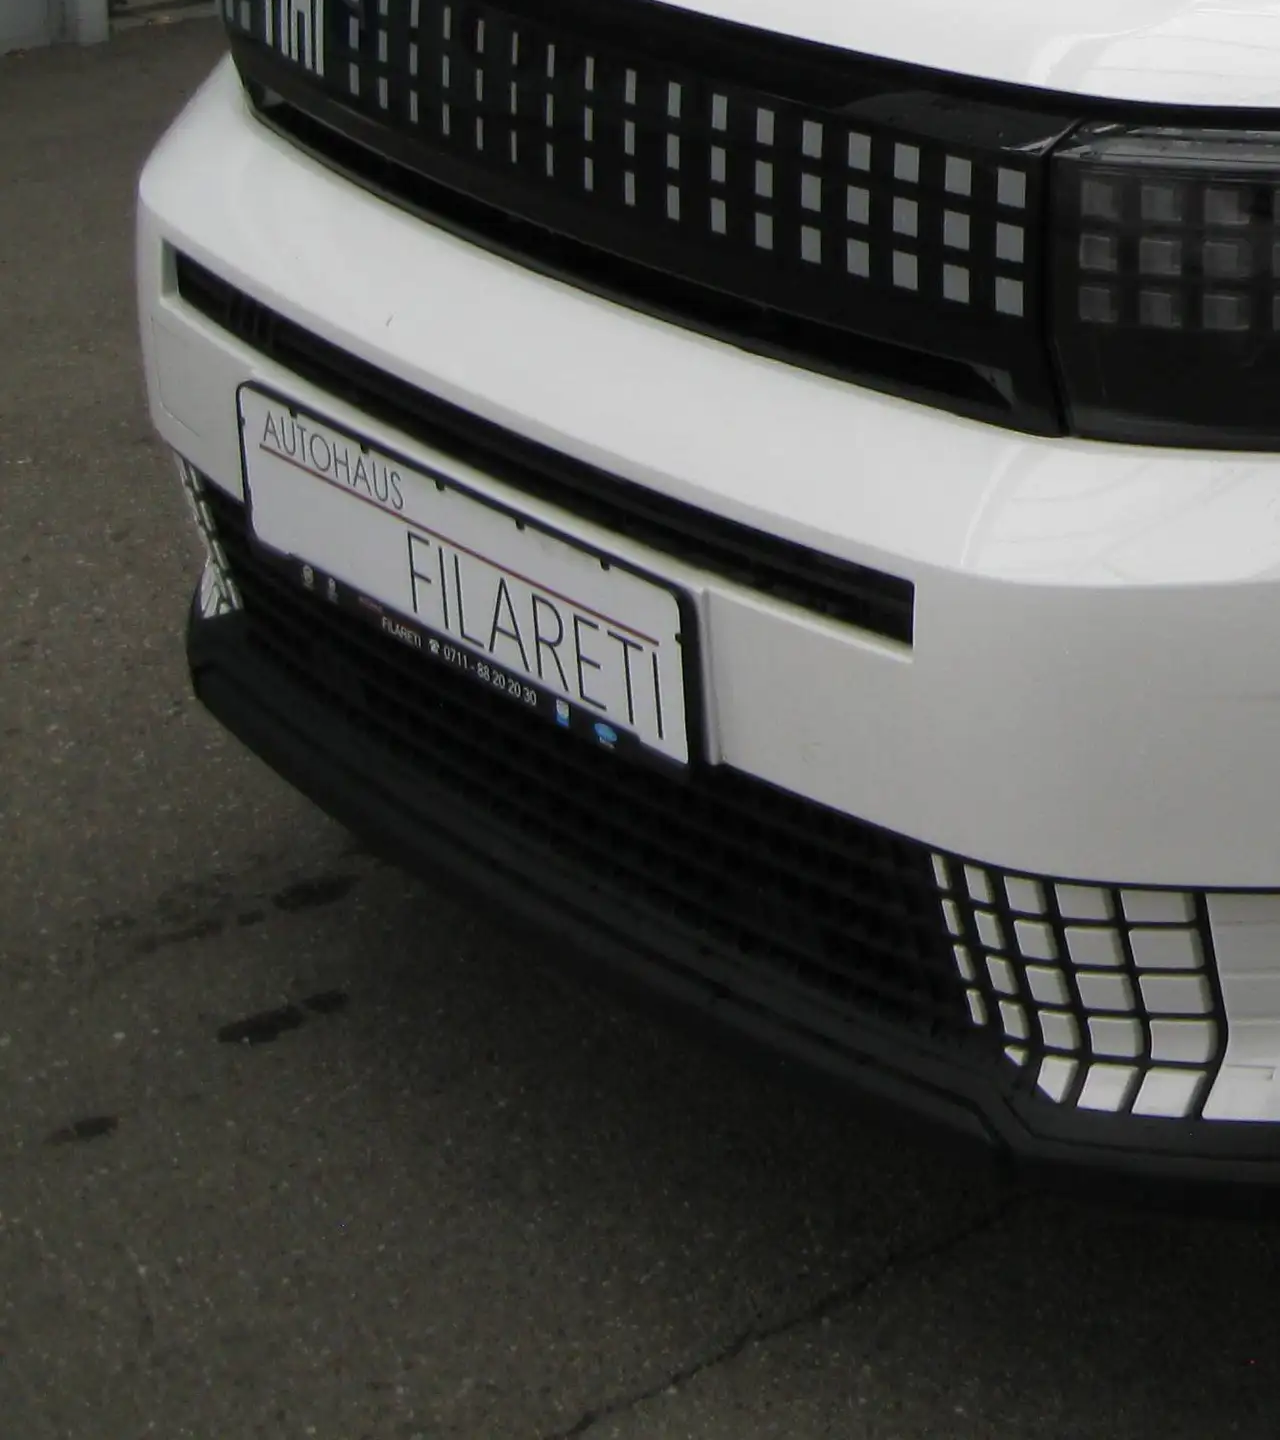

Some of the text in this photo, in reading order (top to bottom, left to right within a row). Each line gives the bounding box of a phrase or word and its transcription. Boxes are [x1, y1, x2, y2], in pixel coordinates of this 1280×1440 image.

[263, 410, 405, 511] AUTOHAUS
[381, 616, 422, 649] FILARETI
[406, 530, 665, 741] FILARETI
[443, 645, 468, 670] 0711
[476, 661, 491, 682] 88
[492, 671, 506, 690] 20
[507, 679, 521, 699] 20
[522, 686, 537, 707] 30
